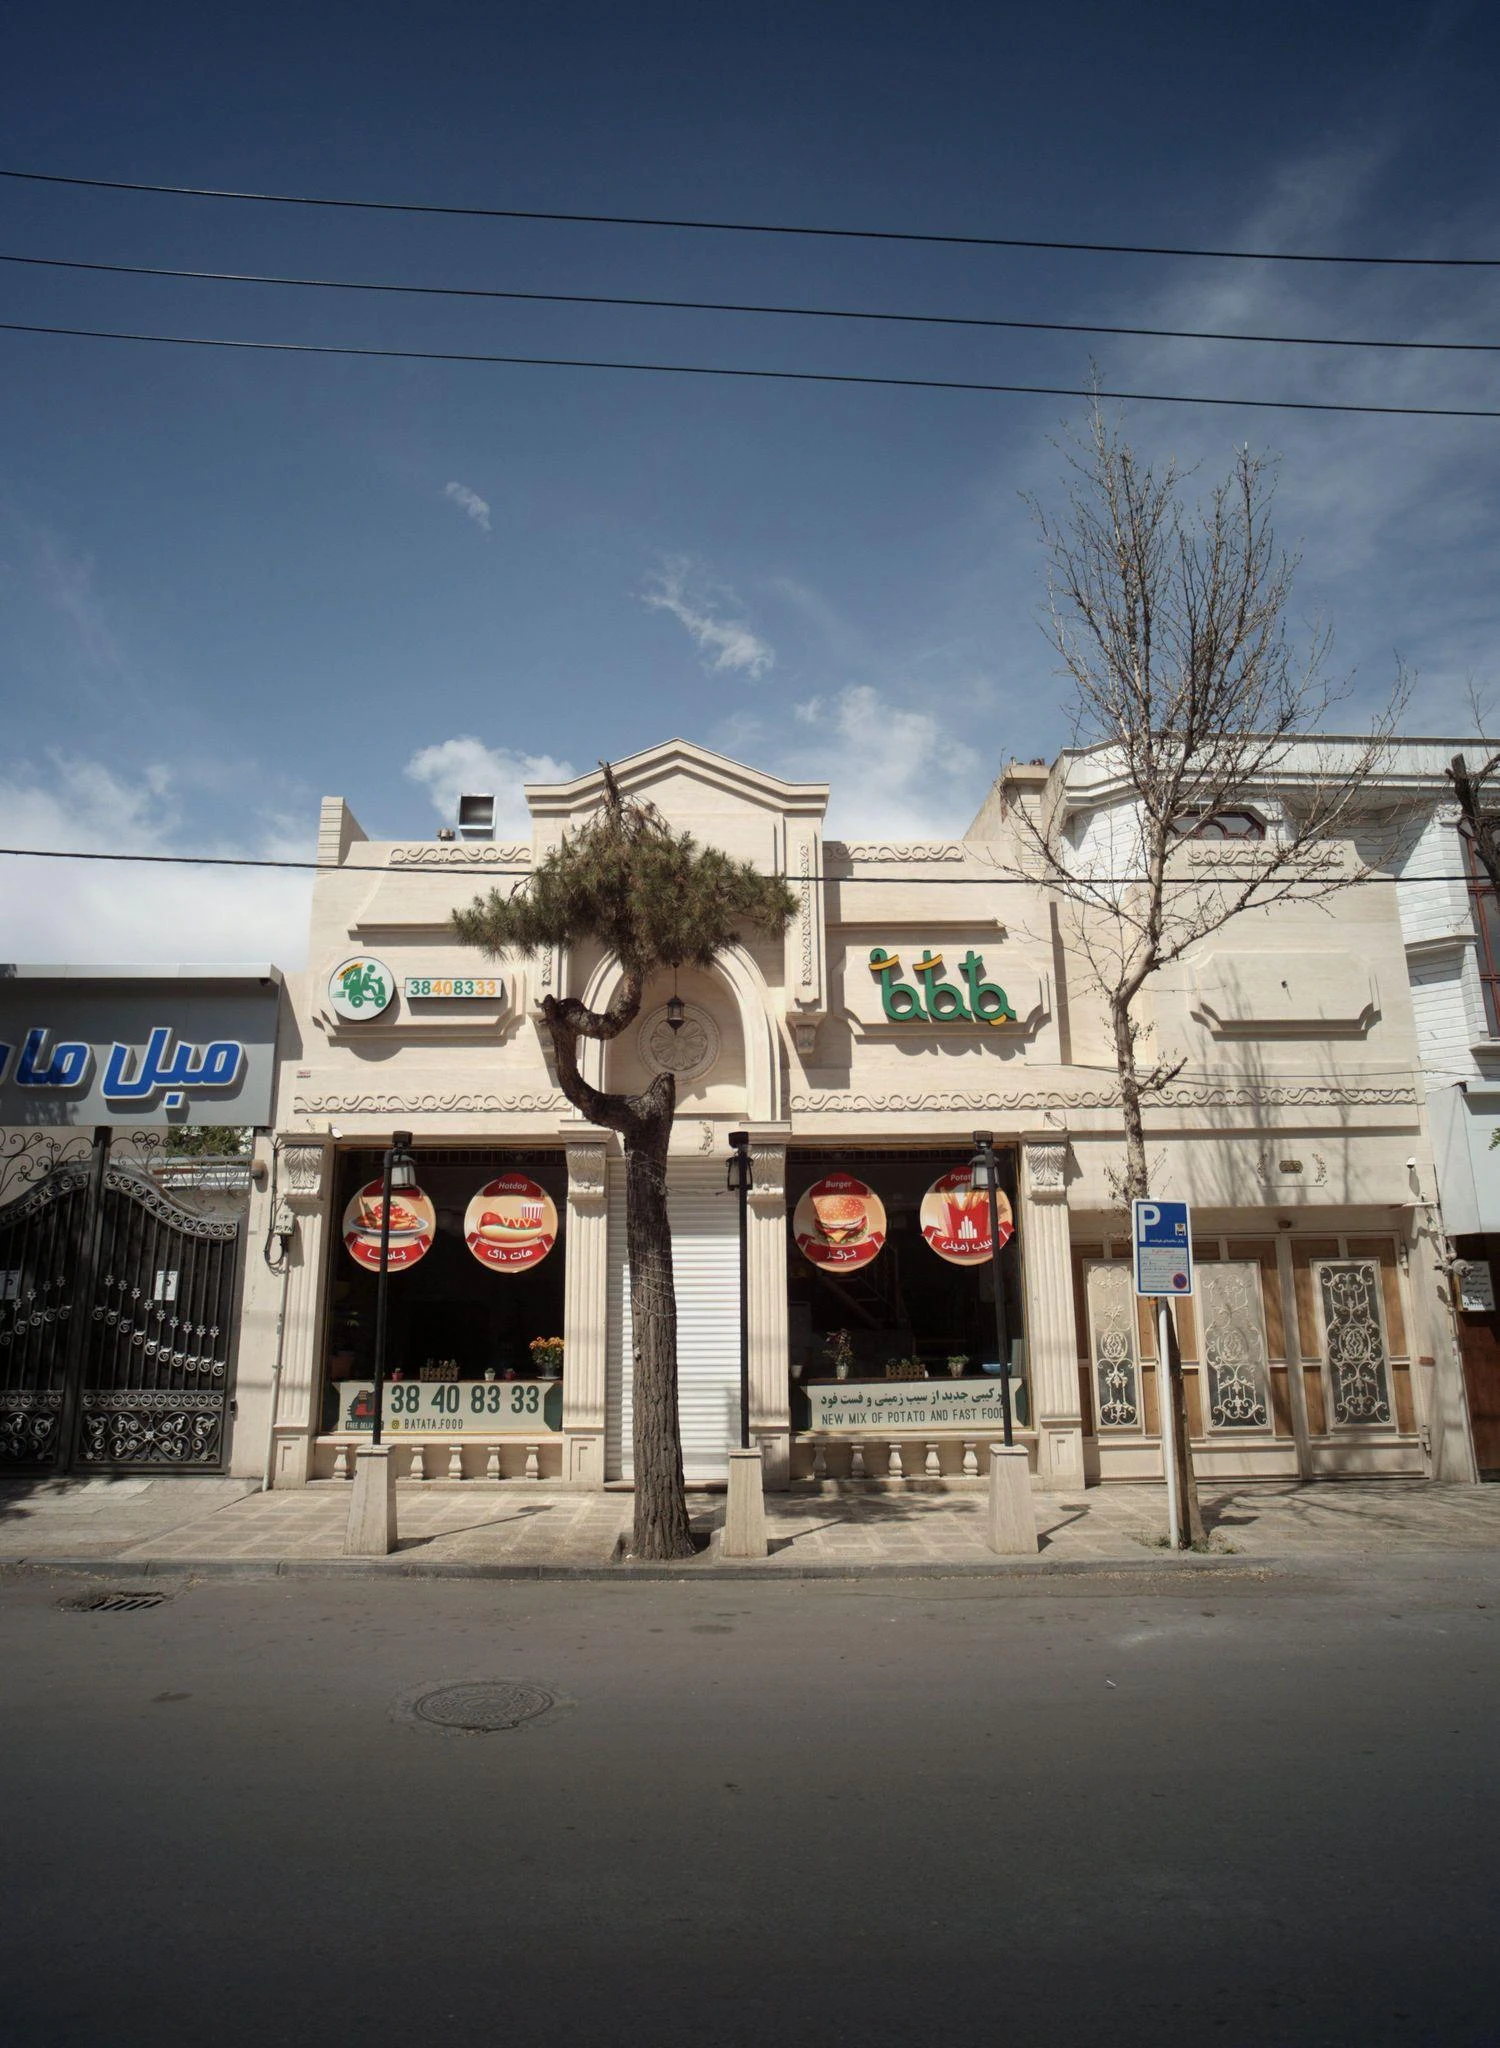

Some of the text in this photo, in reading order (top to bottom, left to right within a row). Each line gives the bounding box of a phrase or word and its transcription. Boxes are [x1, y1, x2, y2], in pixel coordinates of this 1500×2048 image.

[410, 980, 496, 995] 38408333
[0, 1027, 241, 1109] مبل ما
[498, 1181, 528, 1191] Hotdog
[825, 1180, 853, 1190] Burger
[1137, 1204, 1161, 1242] P
[391, 1385, 540, 1414] 38 40 83 33
[820, 1391, 838, 1408] فود
[840, 1391, 863, 1405] فست
[866, 1395, 872, 1407] و
[930, 1389, 940, 1404] از
[971, 1387, 1003, 1403] رکیبی
[821, 1413, 844, 1426] NEW
[849, 1412, 867, 1425] MIX
[872, 1411, 882, 1423] OF
[887, 1410, 925, 1423] POTATO
[930, 1409, 948, 1421] AND
[952, 1408, 976, 1420] FAST
